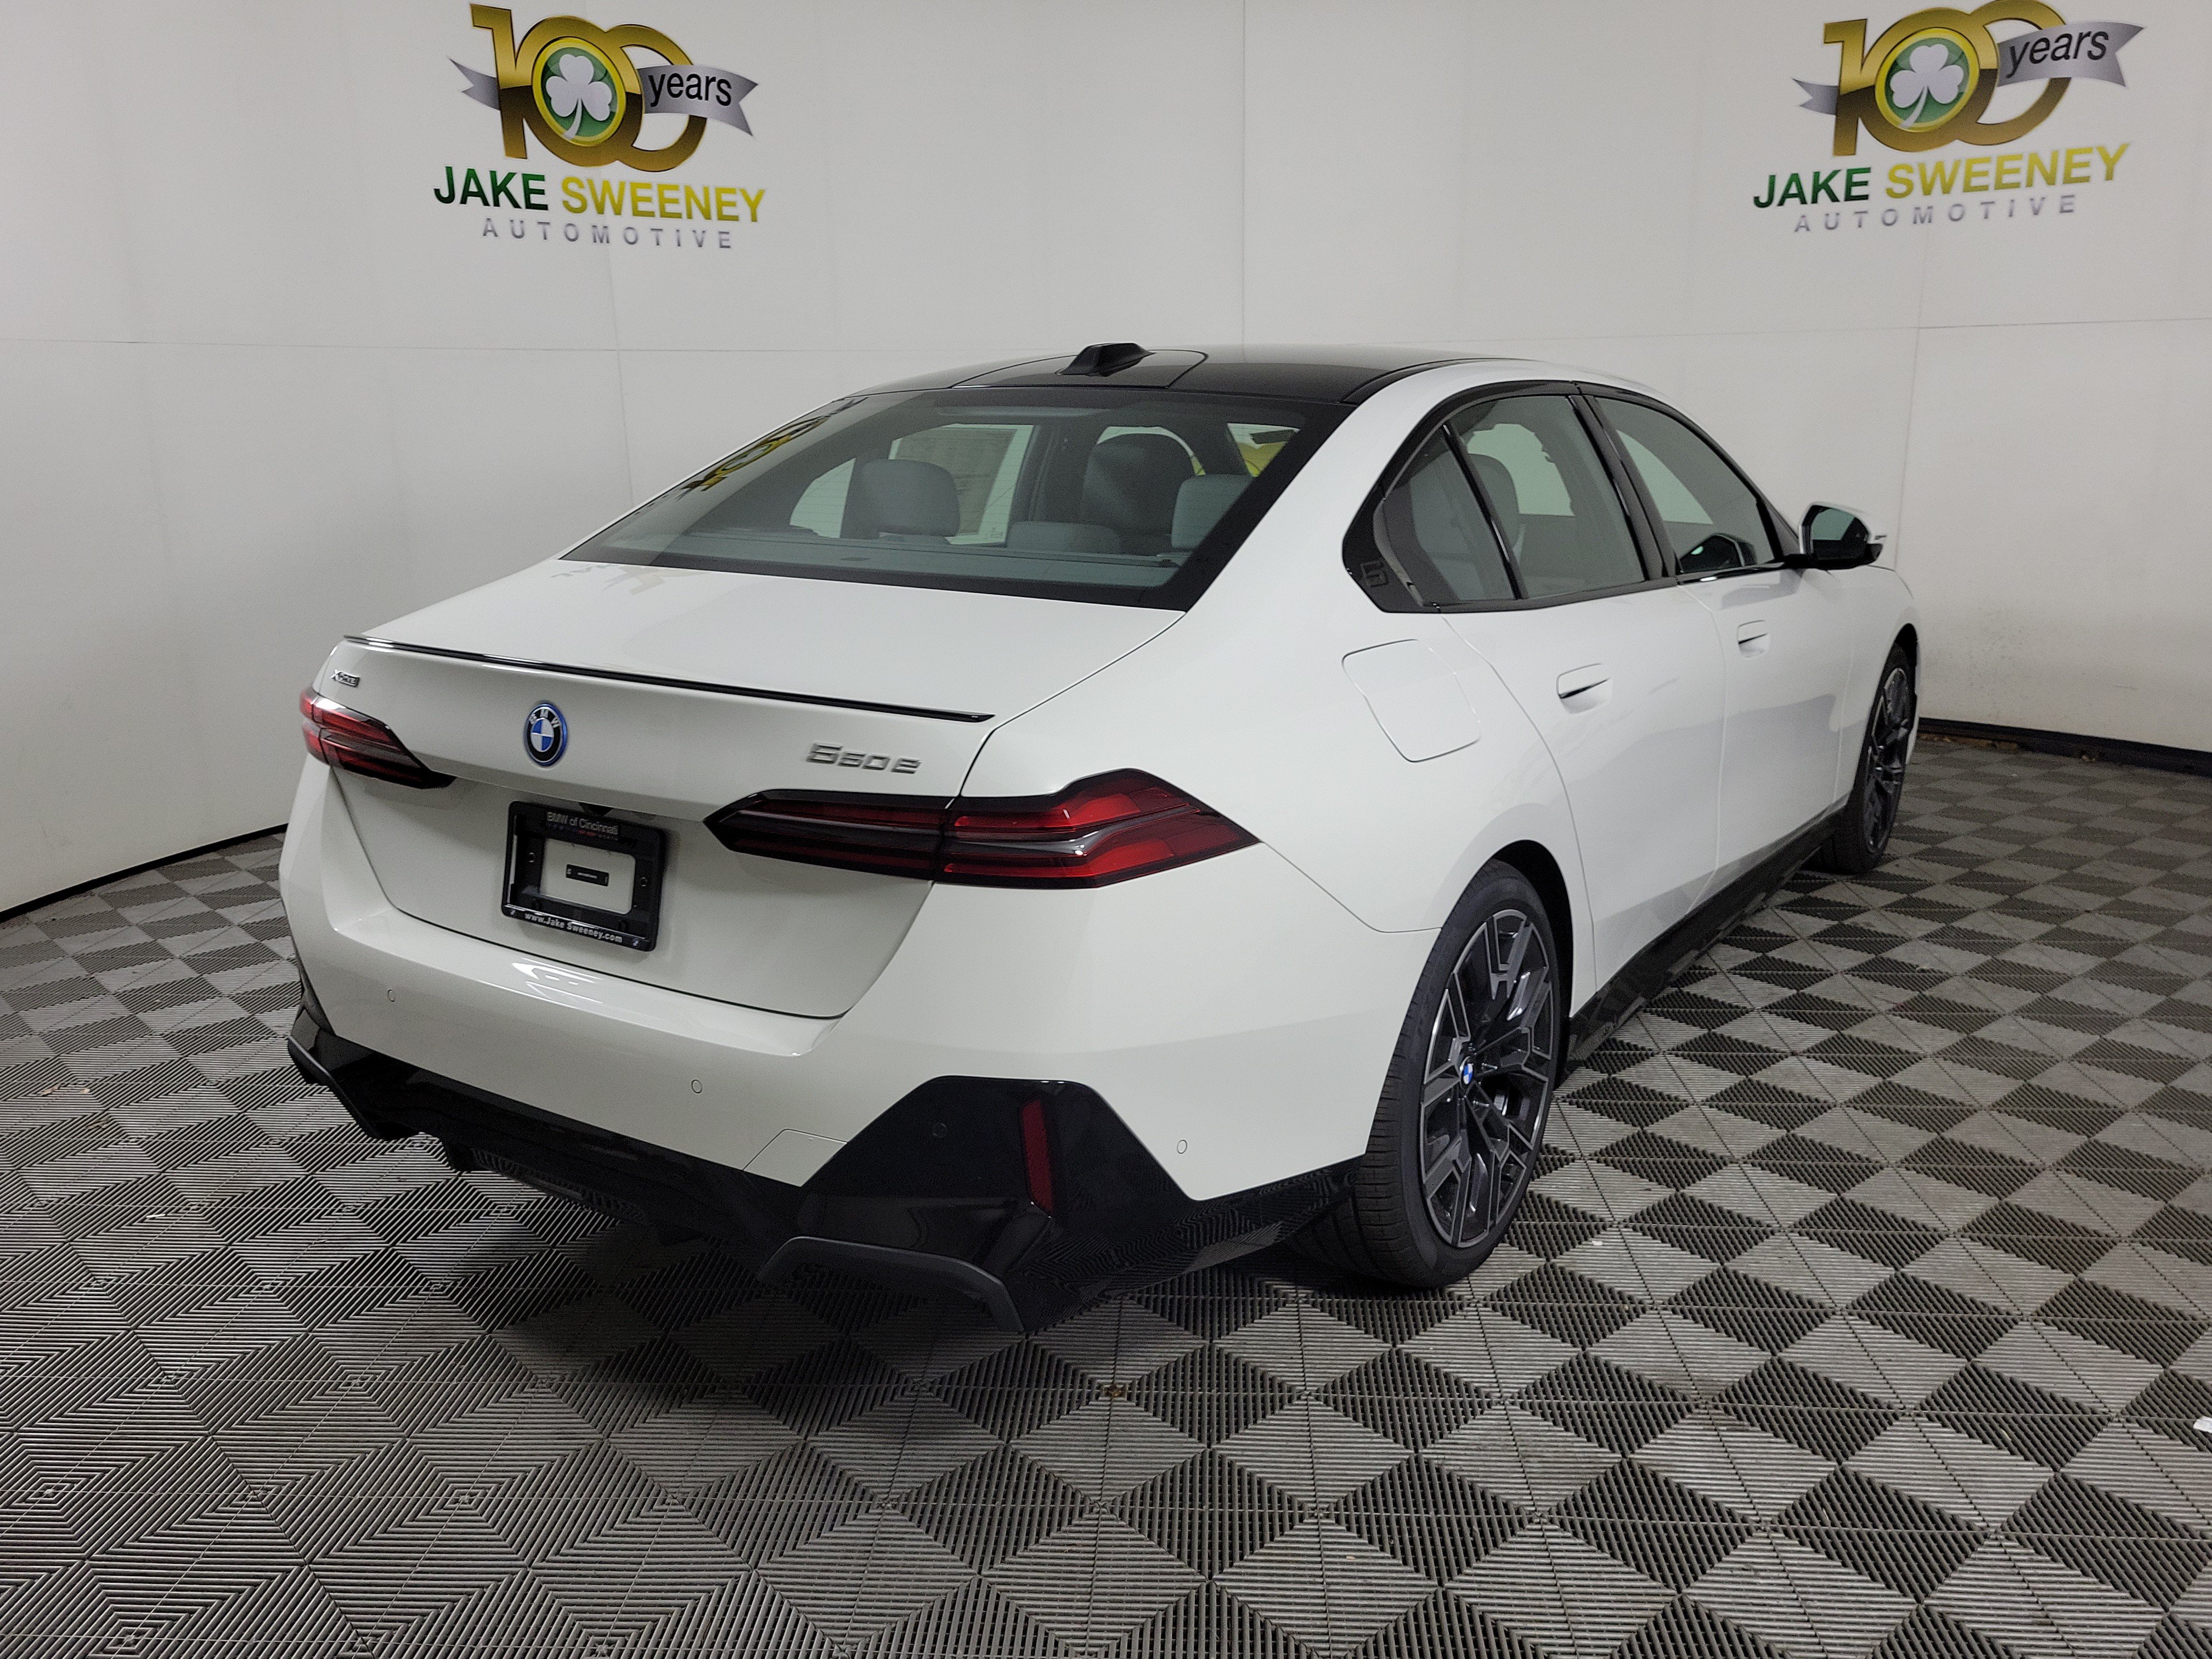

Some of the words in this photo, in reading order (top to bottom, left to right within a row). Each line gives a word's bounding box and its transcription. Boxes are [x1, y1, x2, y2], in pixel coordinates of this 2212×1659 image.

[469, 3, 707, 172] 100
[648, 72, 732, 107] years
[1824, 0, 2072, 157] 100
[2006, 26, 2109, 79] years
[434, 166, 549, 211] JAKE
[561, 176, 765, 222] SWEENEY
[1753, 167, 1871, 208] JAKE
[1886, 143, 2129, 199] SWEENEY
[1794, 194, 2075, 233] AUTOMOTIVE
[482, 218, 731, 249] AUTOMOTIVE
[529, 709, 560, 729] BMW
[547, 812, 568, 824] BMW
[569, 817, 578, 826] of
[525, 912, 565, 928] www.Jake
[567, 922, 623, 943] Sweeney.com
